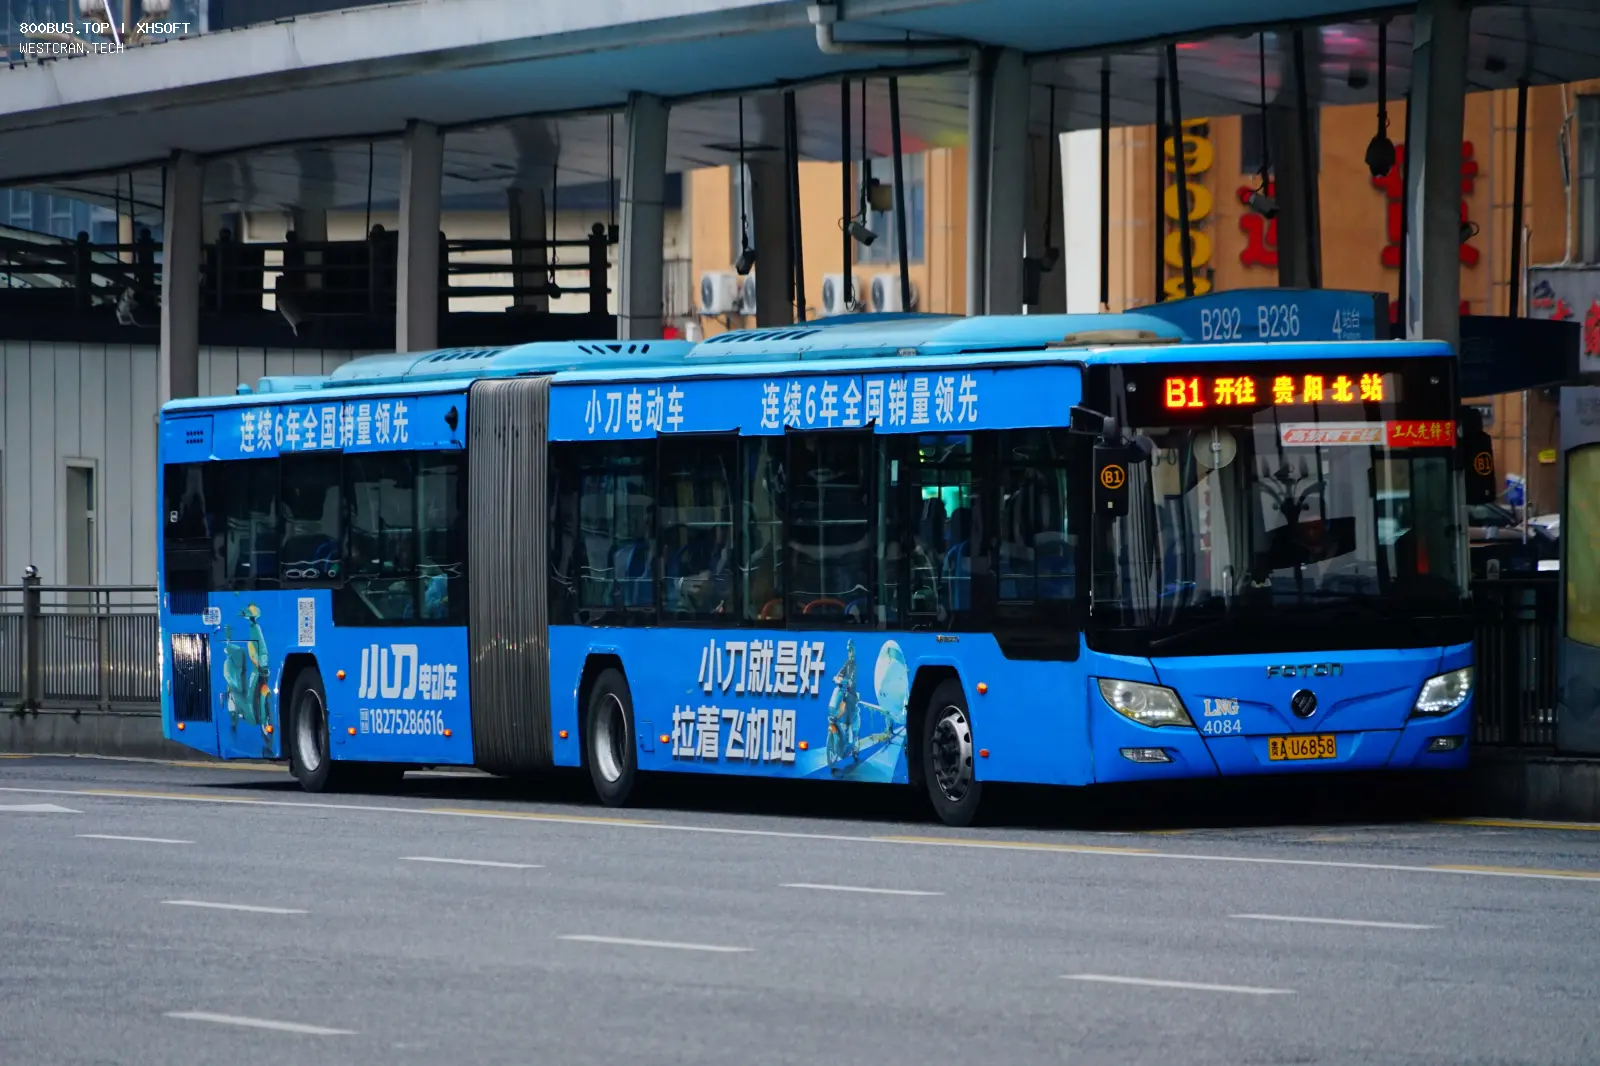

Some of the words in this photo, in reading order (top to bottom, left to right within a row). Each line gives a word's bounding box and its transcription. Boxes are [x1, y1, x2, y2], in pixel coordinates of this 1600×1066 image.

[1201, 307, 1242, 341] B292
[1257, 304, 1300, 338] B236
[761, 373, 979, 429] 连续6年全国销量领先
[1166, 377, 1204, 407] B1
[1214, 376, 1256, 404] 开往
[1272, 373, 1383, 404] 贵阳北站
[584, 385, 685, 434] 小刀电动车
[240, 400, 409, 452] 连续6年全国销量领先
[1391, 421, 1453, 441] 工人先锋号
[1105, 470, 1121, 483] B1
[1478, 457, 1490, 470] B1
[698, 638, 826, 695] 小刀就是好
[1266, 662, 1343, 679] FOTON
[369, 708, 445, 736] 18275286616
[1203, 698, 1239, 716] LNG
[672, 704, 796, 763] 拉着飞机跑
[1203, 719, 1242, 735] 4084
